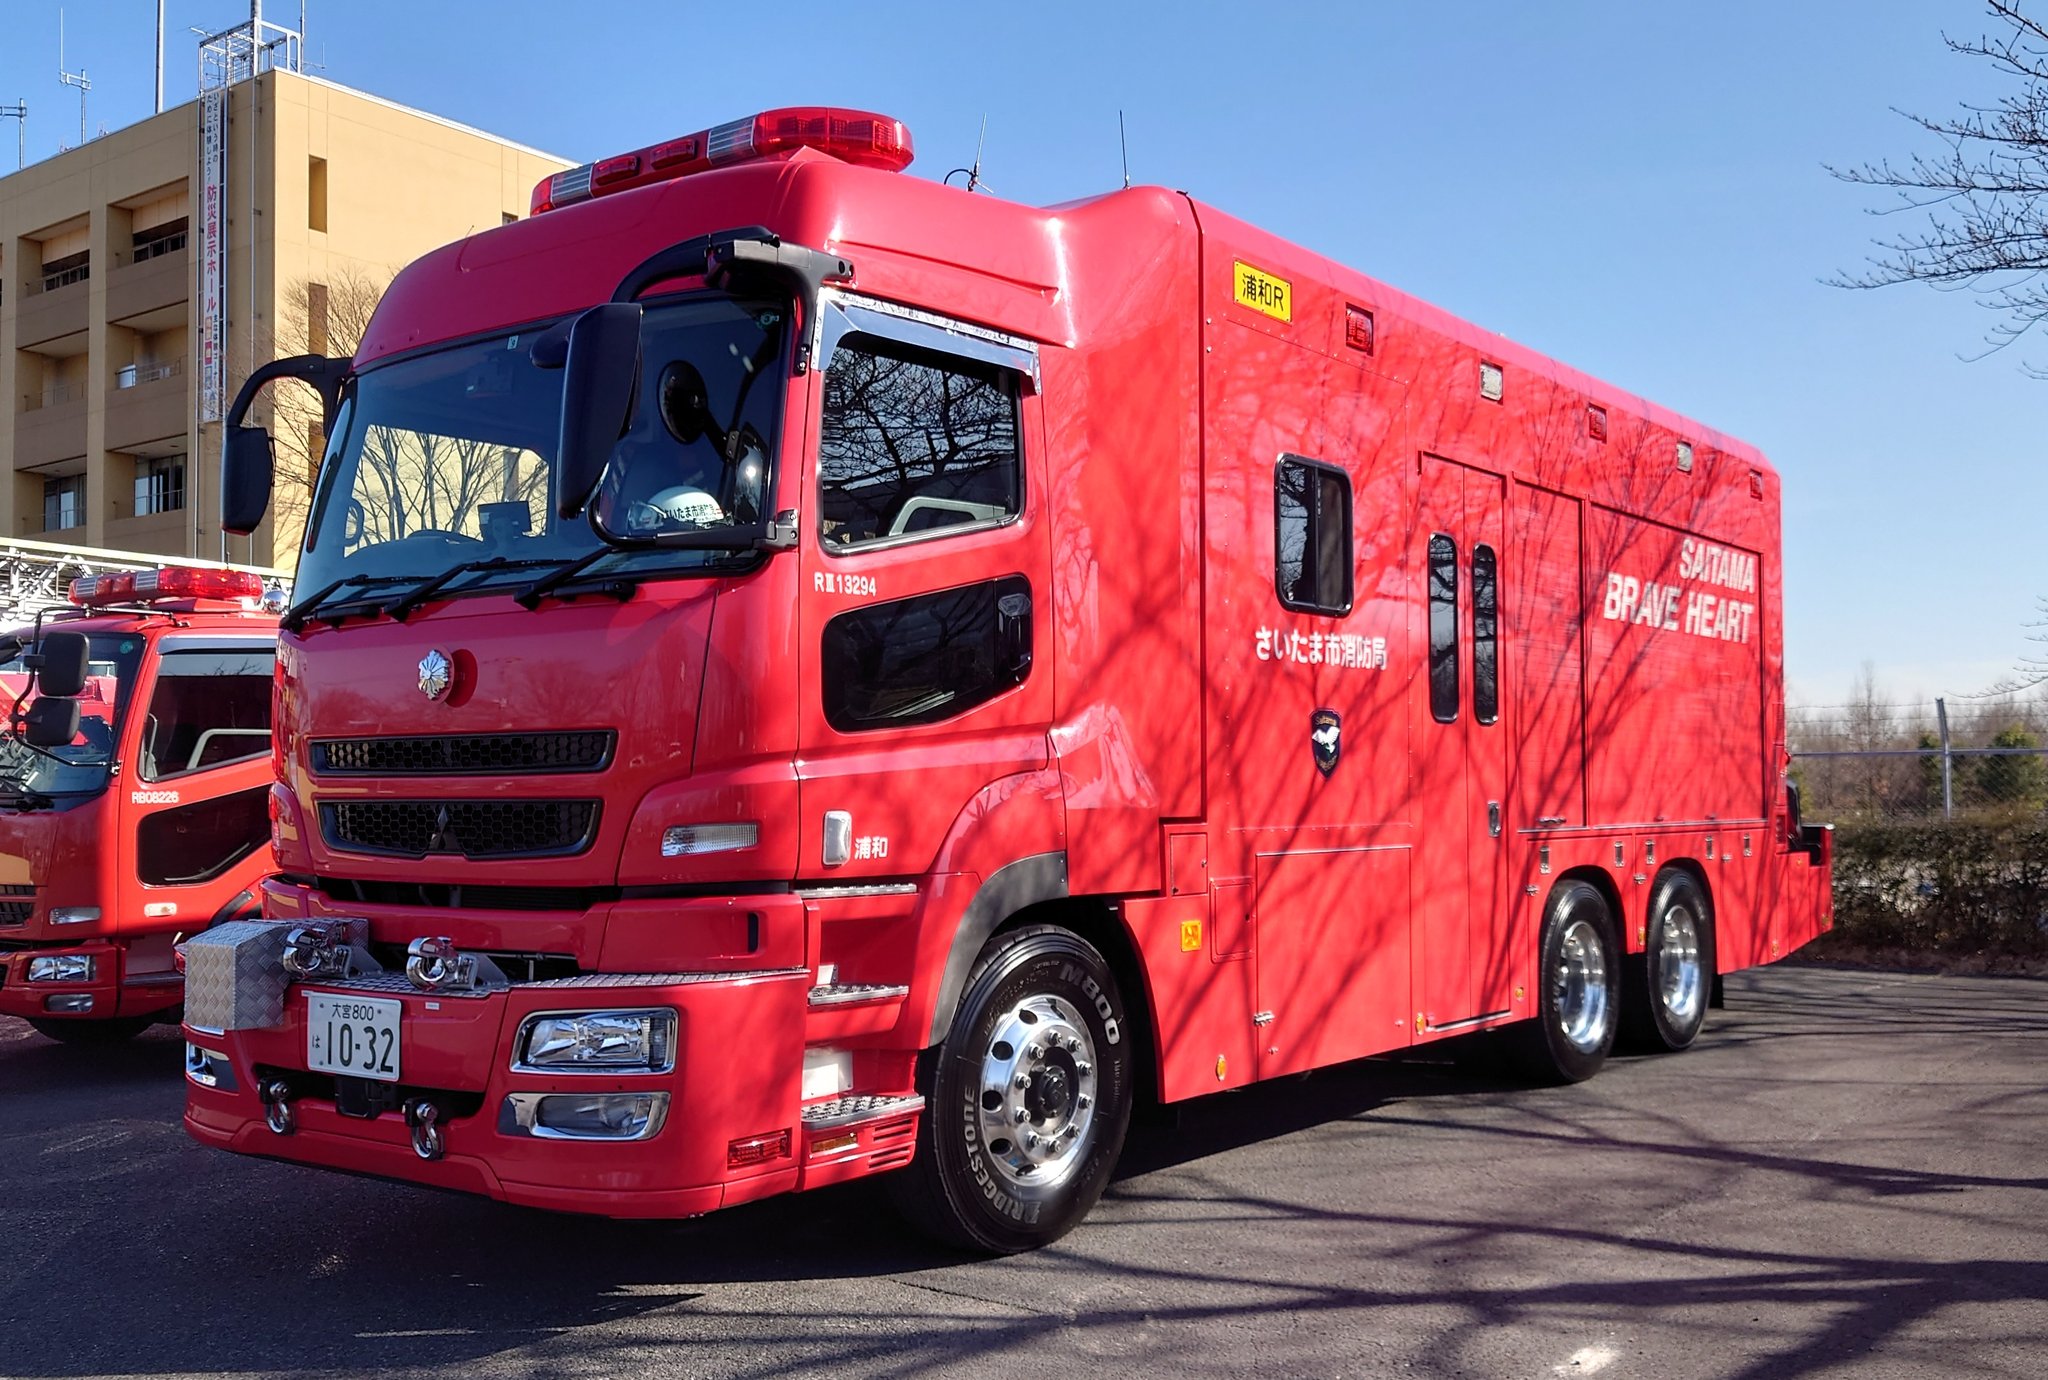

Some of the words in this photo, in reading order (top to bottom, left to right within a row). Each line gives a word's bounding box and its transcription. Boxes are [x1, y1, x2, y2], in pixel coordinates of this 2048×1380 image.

[206, 184, 217, 313] 防災展示ホール
[1242, 272, 1284, 312] 浦和R
[1679, 538, 1755, 594] SAITAMA
[1603, 571, 1681, 632] BRAVE
[1685, 591, 1755, 645] HEART
[1255, 625, 1388, 671] さいたま市消防局
[854, 835, 889, 860] 浦和
[1058, 962, 1121, 1046] M800
[311, 1034, 321, 1049] は
[962, 1086, 1042, 1225] BRIDGESTONE
